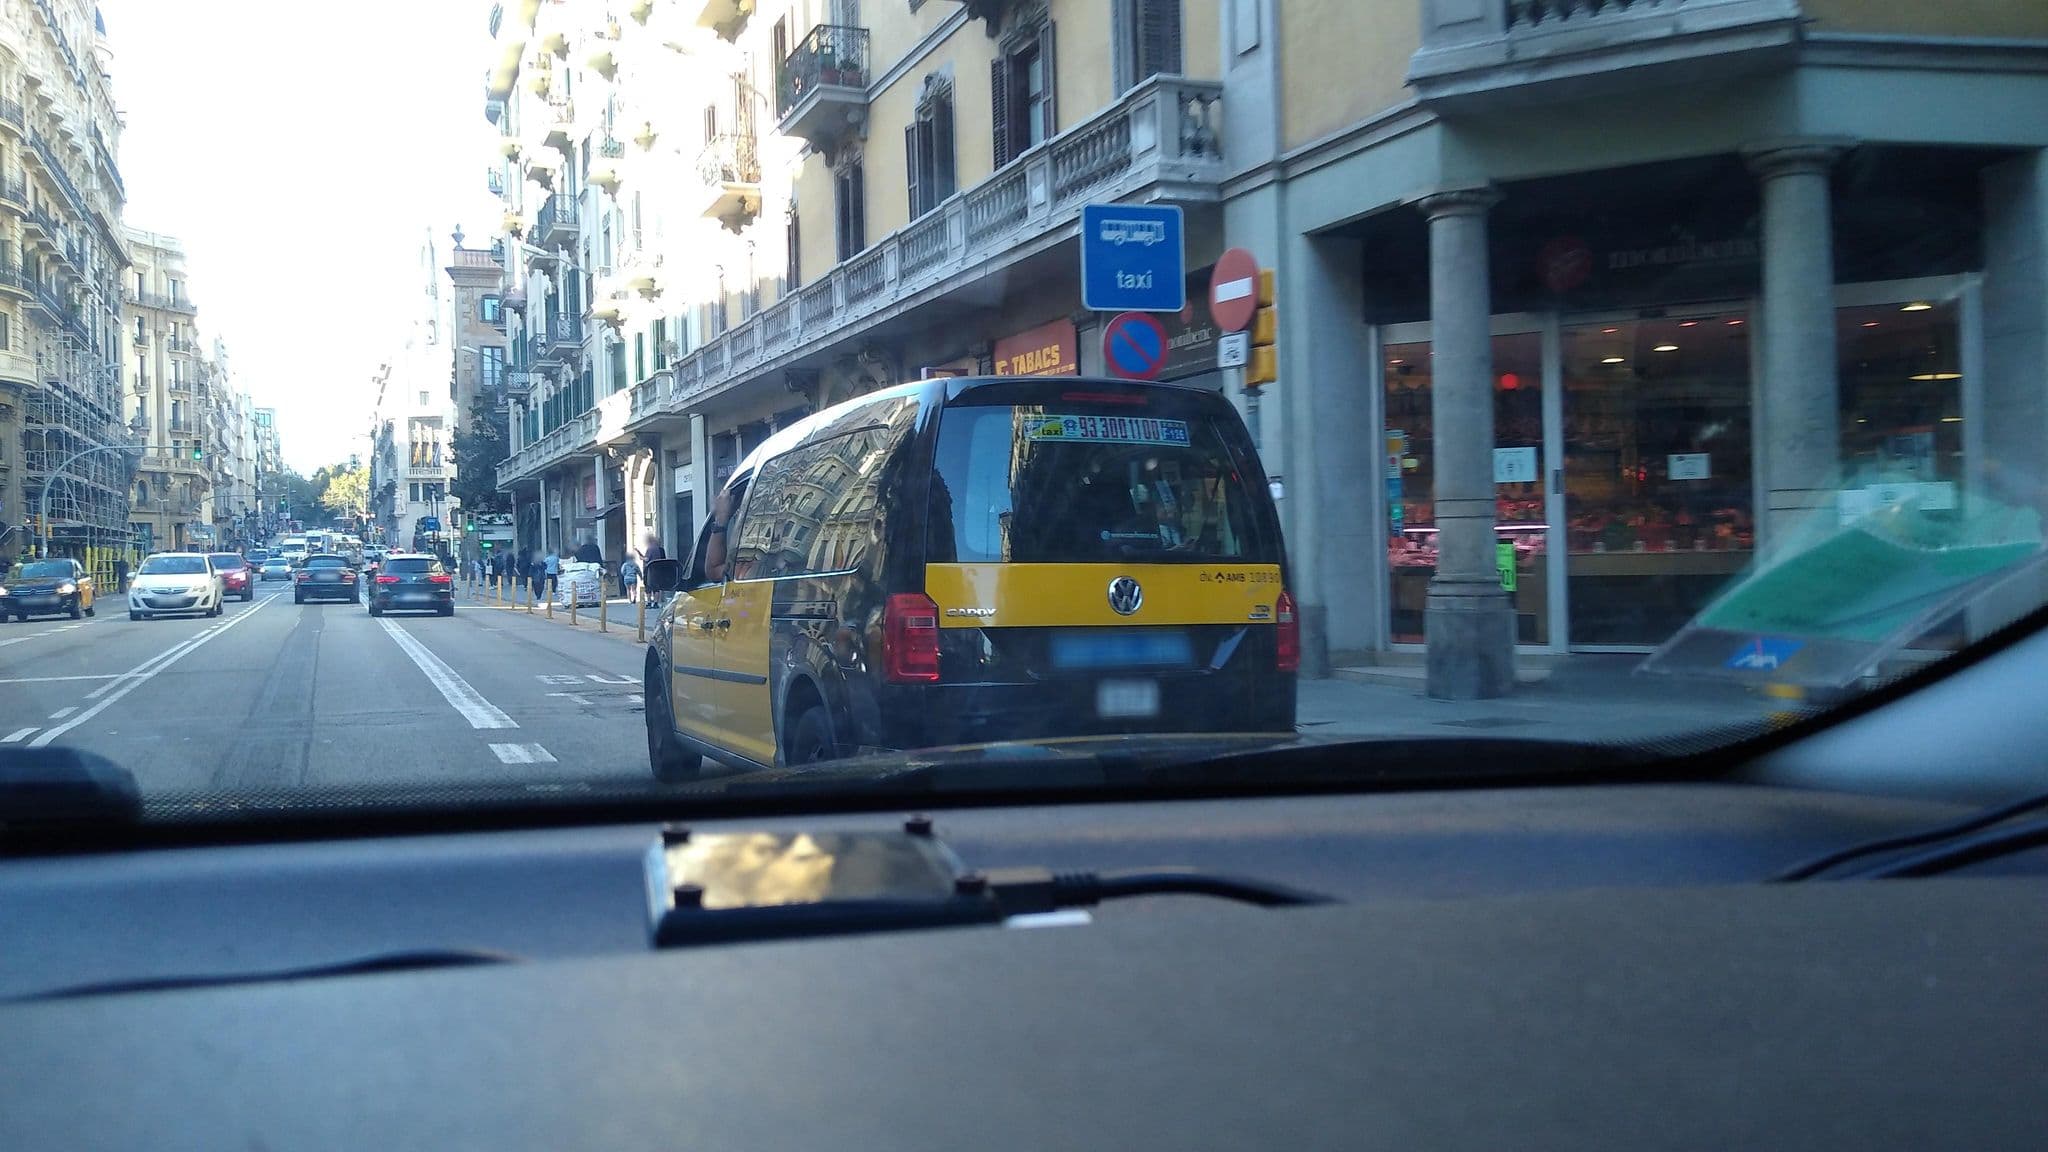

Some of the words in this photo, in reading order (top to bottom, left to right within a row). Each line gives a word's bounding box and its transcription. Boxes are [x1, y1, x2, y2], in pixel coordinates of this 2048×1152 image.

[1011, 344, 1060, 376] TABACS
[1041, 427, 1064, 436] taxi
[1078, 416, 1098, 438] 93
[945, 607, 997, 618] CADDY
